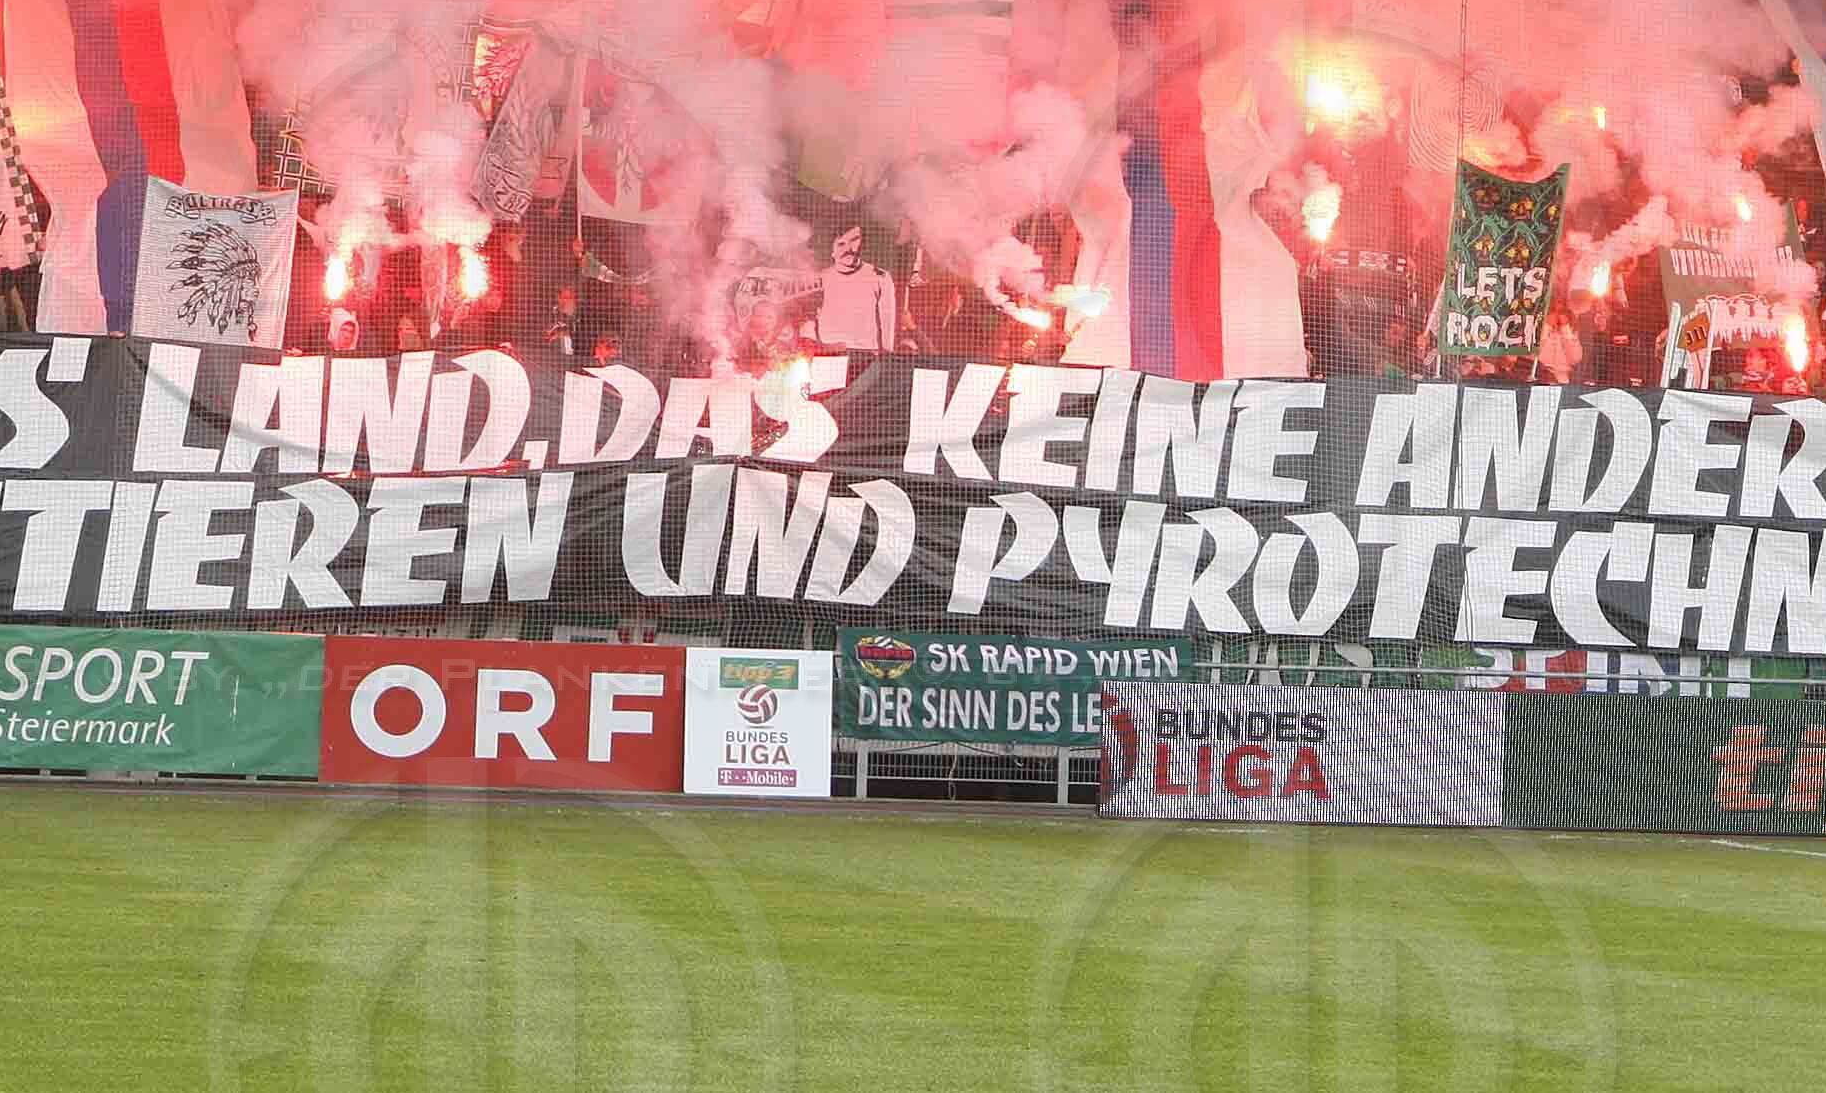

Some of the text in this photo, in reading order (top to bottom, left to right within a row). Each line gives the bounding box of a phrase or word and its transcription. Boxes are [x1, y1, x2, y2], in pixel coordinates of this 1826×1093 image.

[182, 193, 260, 217] ULTRAS
[1455, 262, 1547, 304] LETS
[904, 364, 1324, 504] KEINE
[621, 463, 917, 606] UND
[929, 641, 972, 674] SK
[980, 643, 1078, 677] RAPID
[1083, 647, 1179, 679] WIEN
[349, 663, 665, 763] ORF
[857, 684, 915, 730] DER
[921, 685, 1001, 732] SINN
[1006, 686, 1061, 733] DES
[1153, 707, 1327, 744] BUNDES
[724, 729, 790, 747] BUNDES
[724, 743, 792, 767] LIGA
[1152, 743, 1332, 802] LIGA
